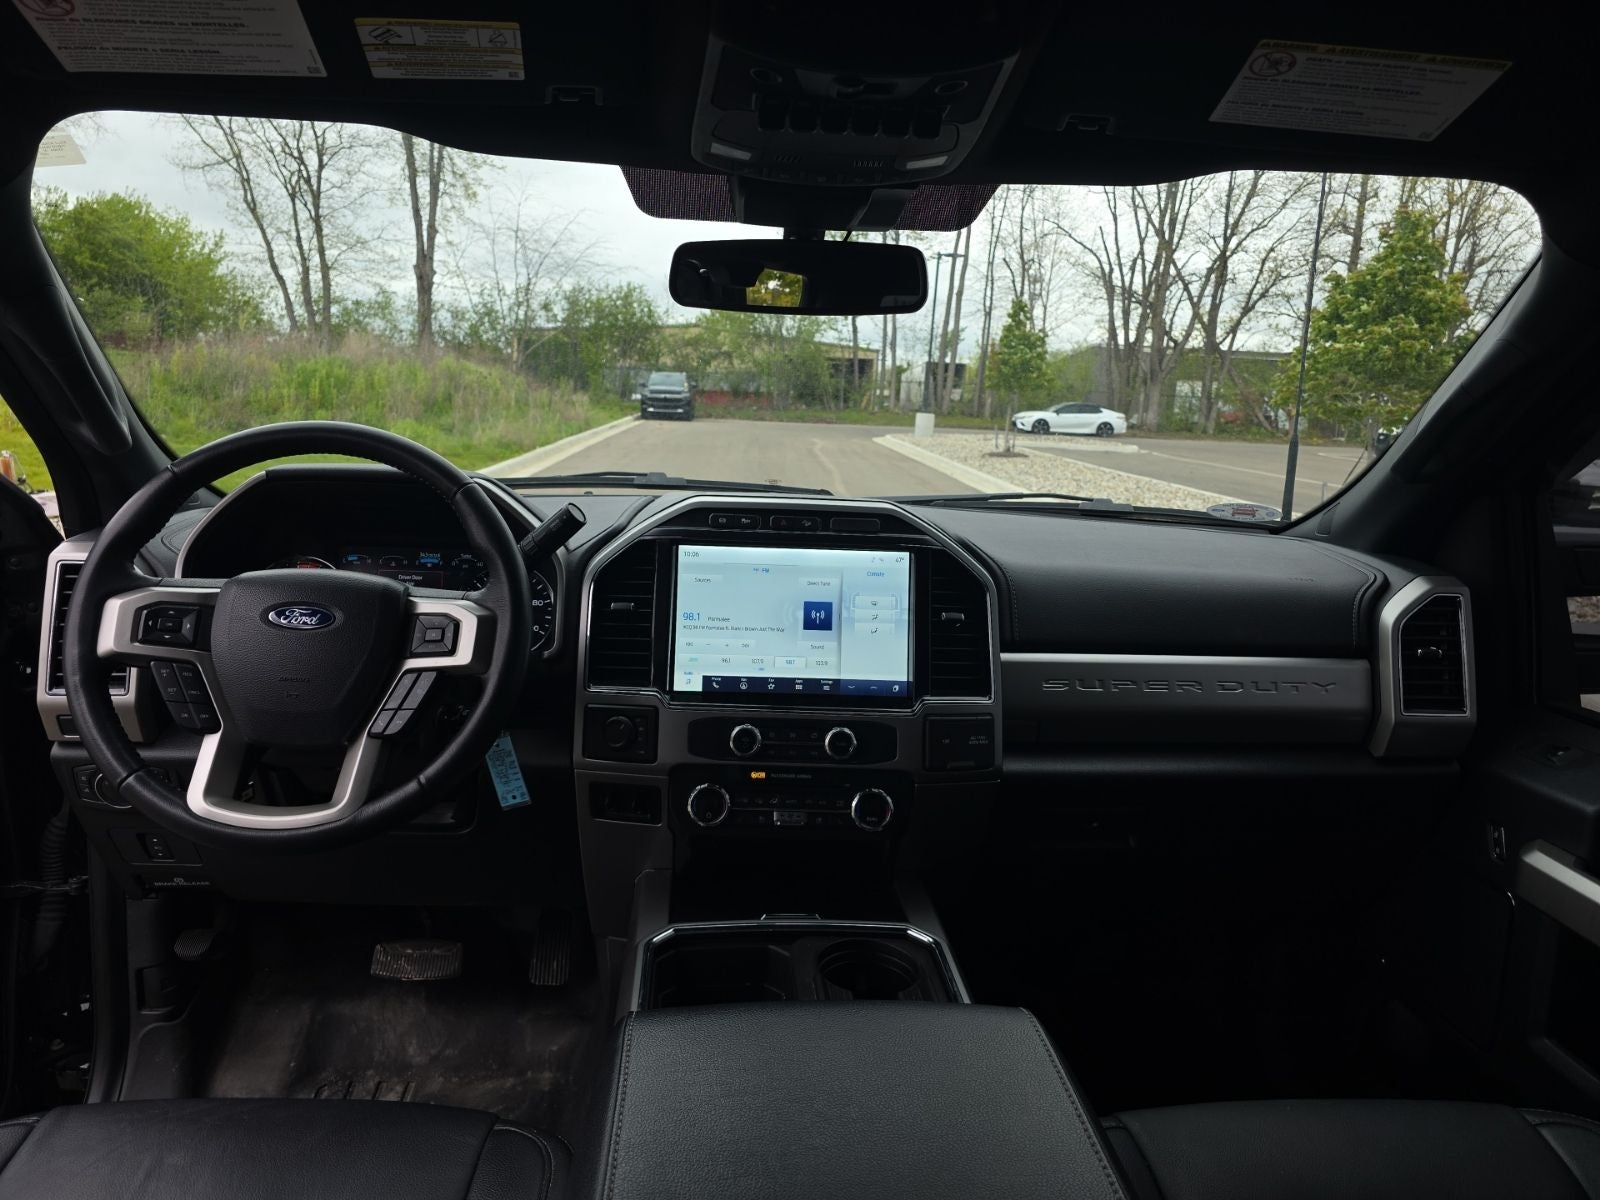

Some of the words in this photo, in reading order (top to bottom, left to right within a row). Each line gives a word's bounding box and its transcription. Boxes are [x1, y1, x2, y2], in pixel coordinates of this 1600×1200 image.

[281, 608, 322, 625] Ford
[682, 611, 700, 621] 98.1
[1042, 680, 1204, 693] SUPER
[1216, 680, 1336, 694] DUTY
